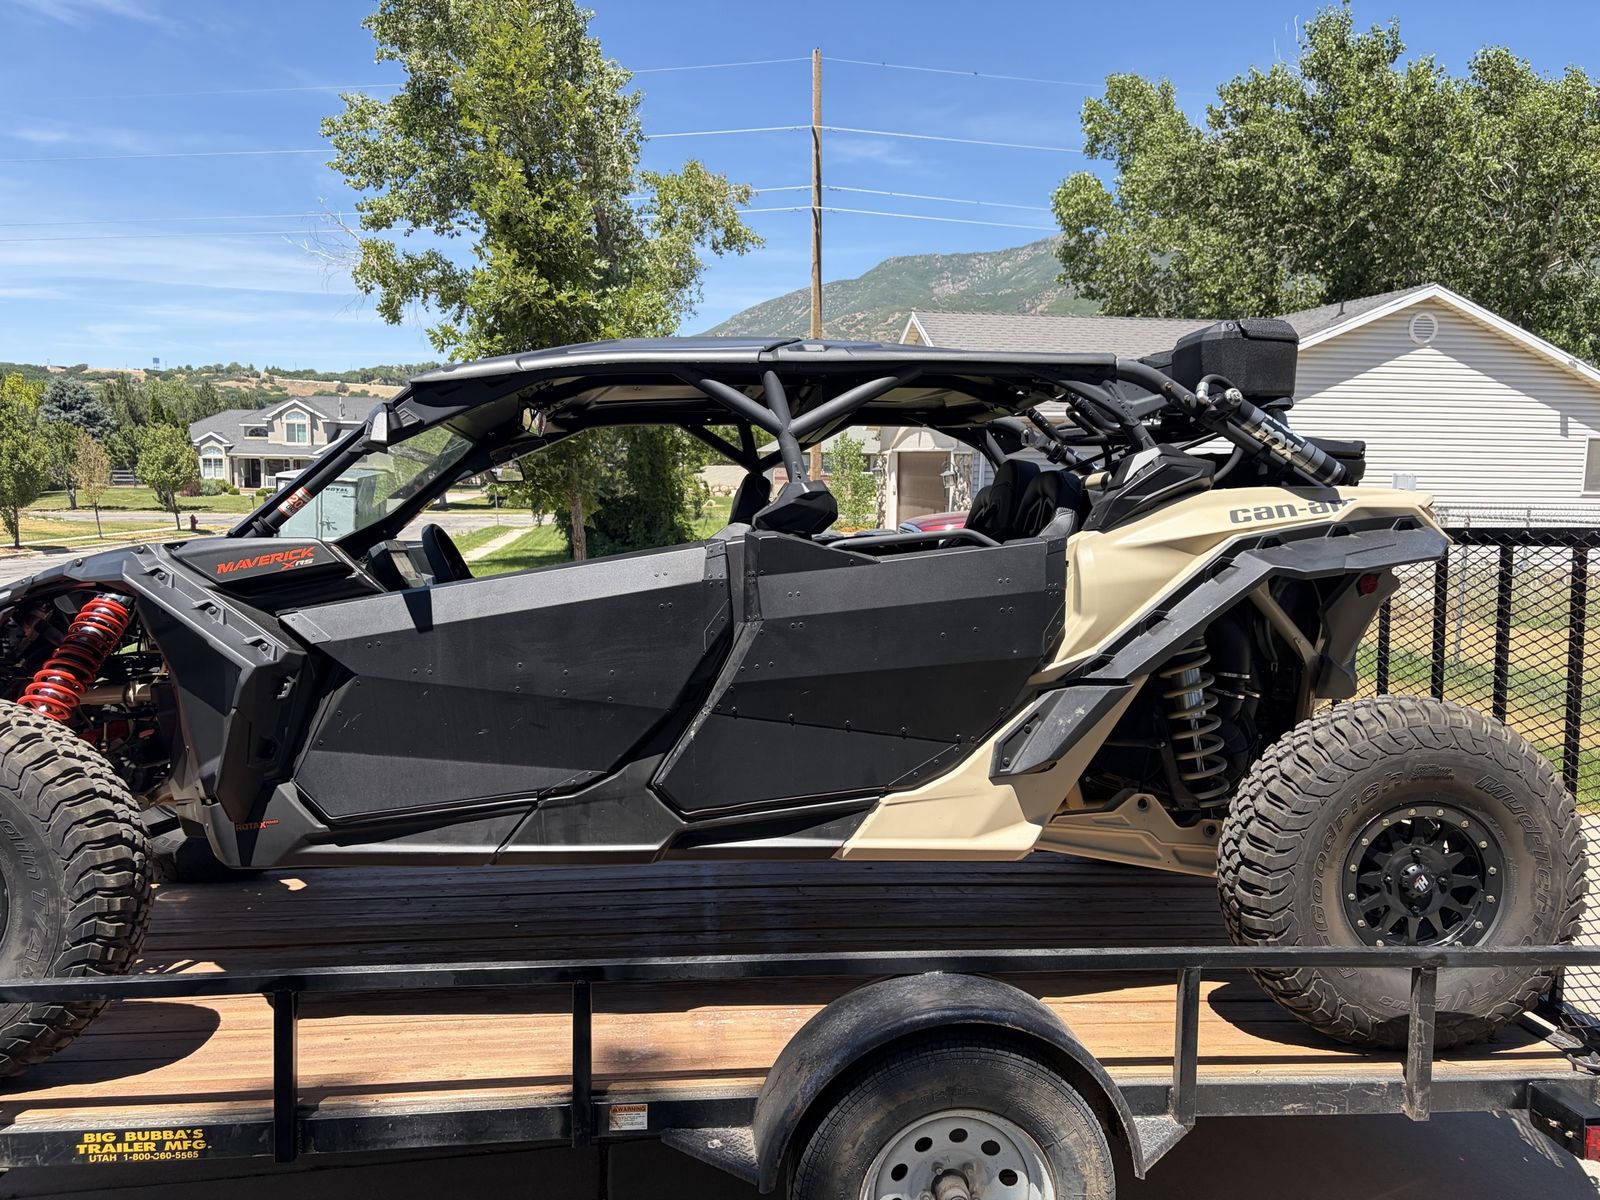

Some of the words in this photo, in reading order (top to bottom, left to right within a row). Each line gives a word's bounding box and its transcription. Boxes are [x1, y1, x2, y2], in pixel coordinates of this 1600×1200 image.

[216, 546, 316, 575] MAVERICK
[83, 1132, 117, 1143] BIG
[124, 1129, 204, 1142] BUBBA'S
[76, 1142, 157, 1154] TRAILER
[89, 1154, 117, 1162] UTAH
